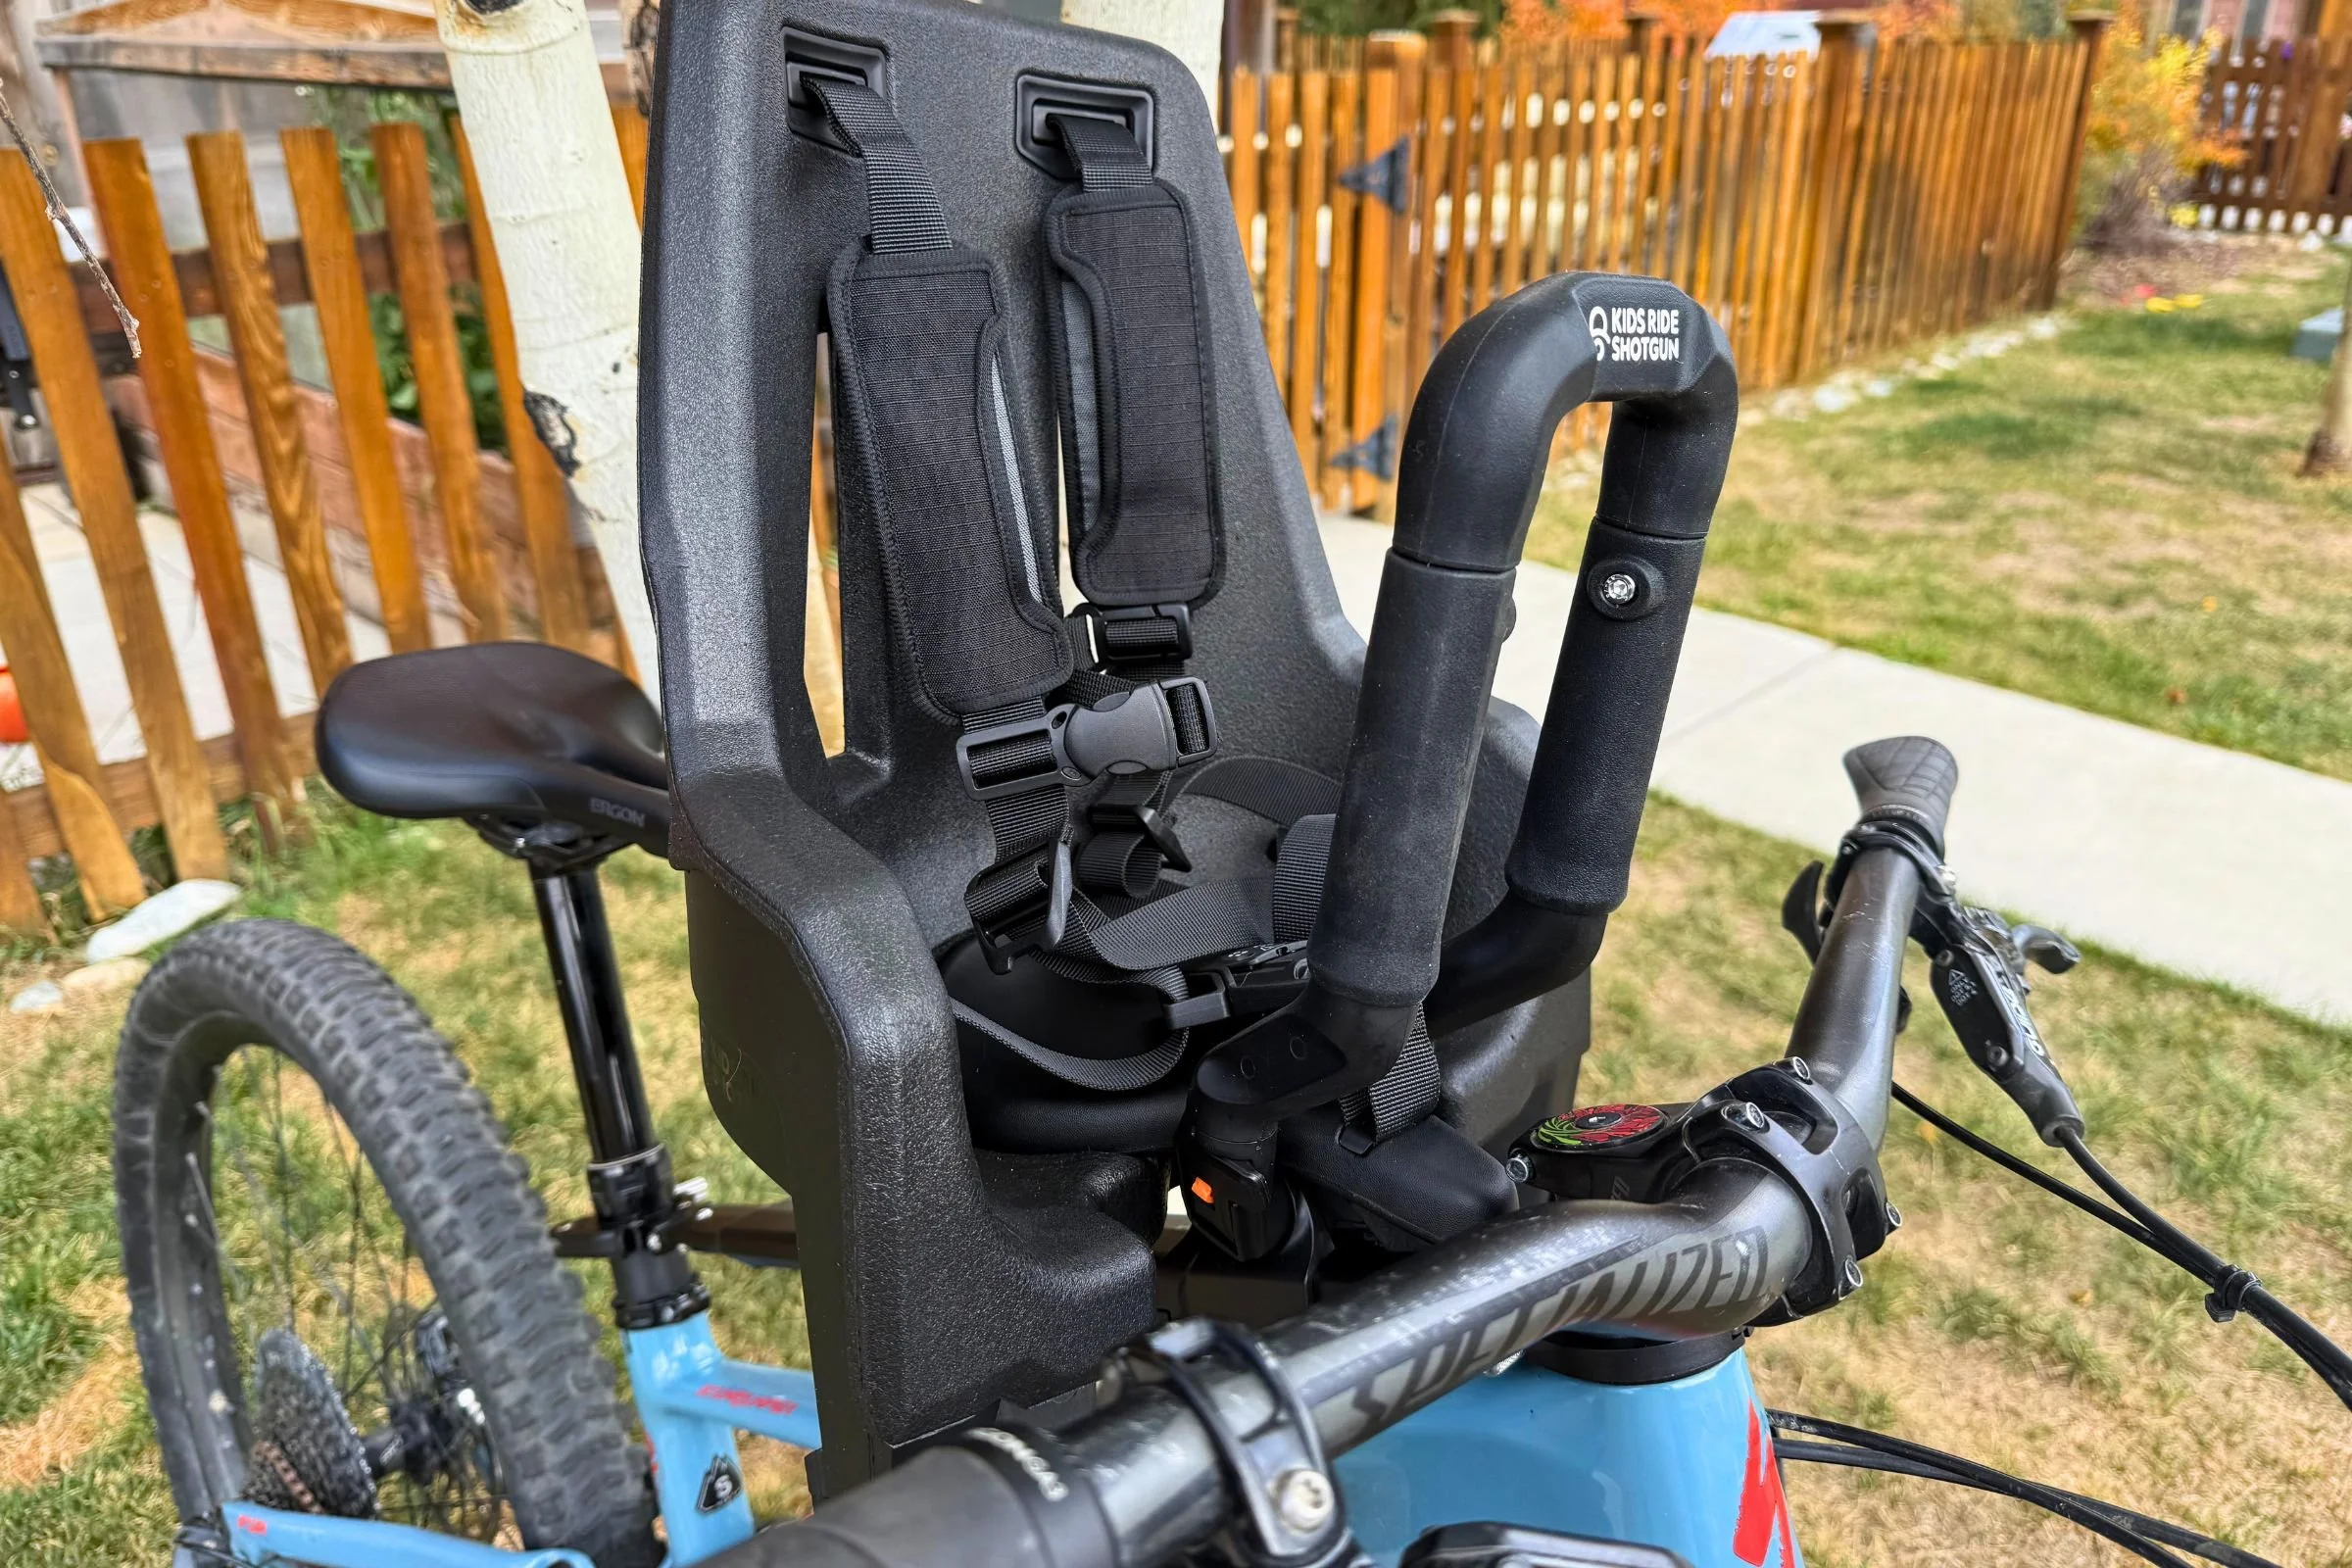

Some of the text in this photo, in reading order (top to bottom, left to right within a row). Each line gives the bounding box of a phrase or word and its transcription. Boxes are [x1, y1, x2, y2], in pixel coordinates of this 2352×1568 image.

[1611, 307, 1680, 335] KIDS RIDE
[1611, 335, 1680, 362] SHOTGUN
[590, 797, 646, 828] ERGON
